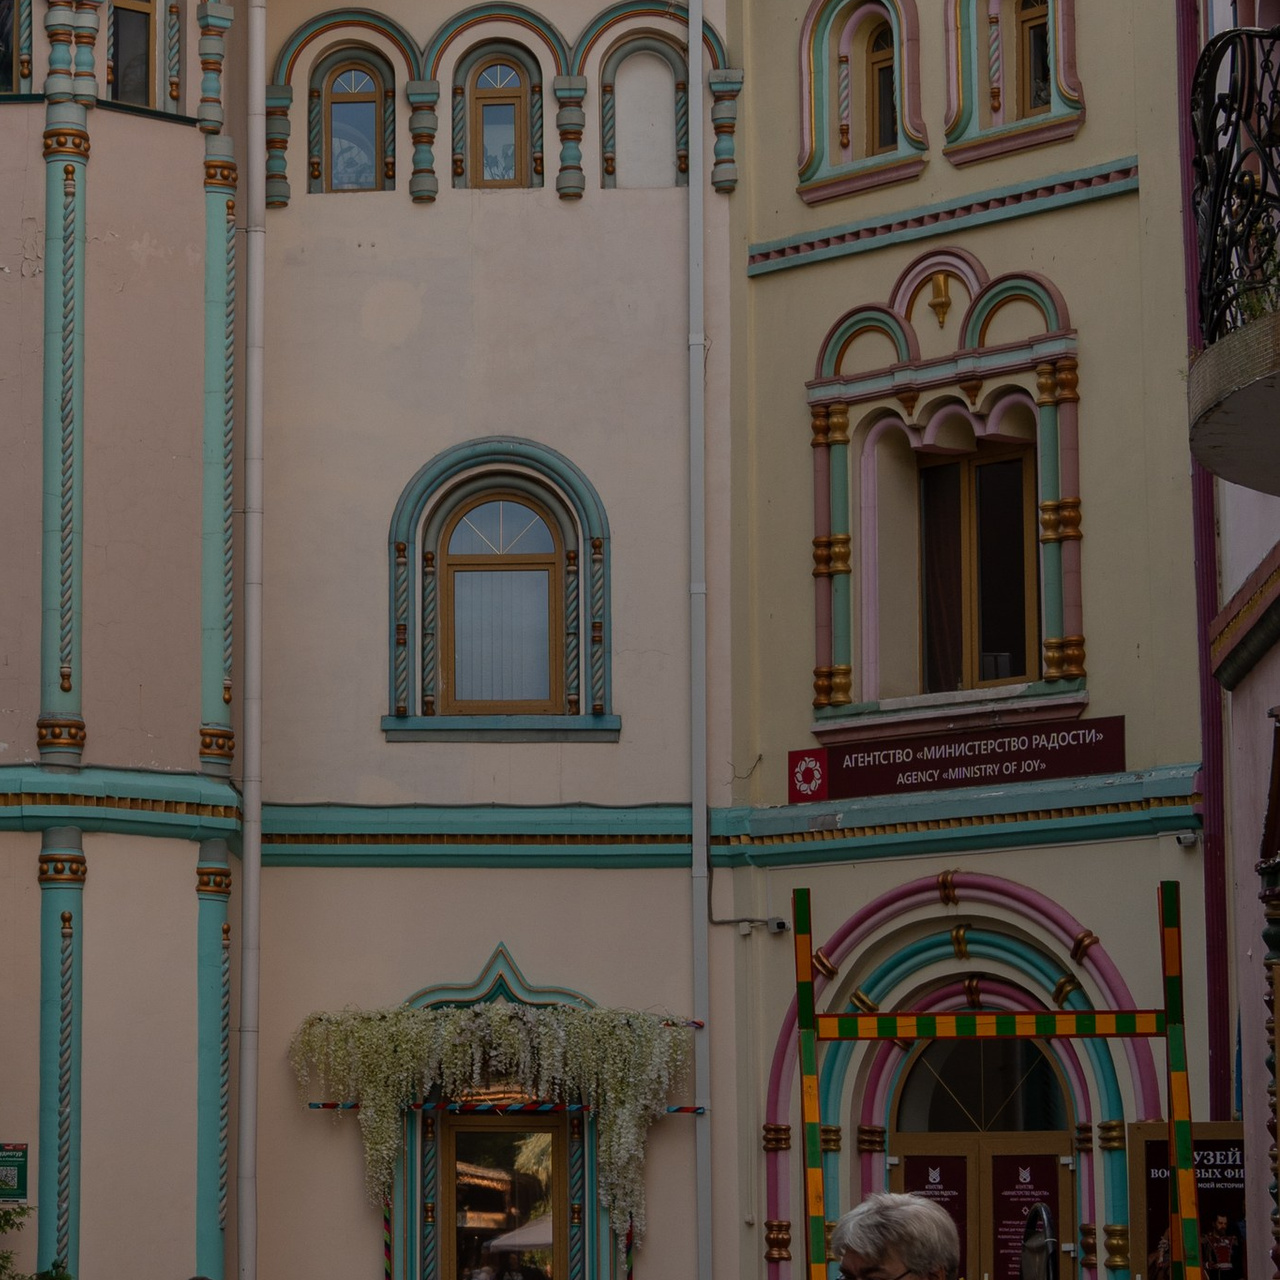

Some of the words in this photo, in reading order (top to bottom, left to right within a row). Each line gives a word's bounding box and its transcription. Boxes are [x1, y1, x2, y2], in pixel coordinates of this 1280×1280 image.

[842, 746, 913, 769] АГЕНТСТВО
[916, 734, 1029, 761] «МИНИСТЕРСТВО
[1032, 728, 1104, 751] РАДОСТИ»
[896, 769, 940, 785] AGENCY
[942, 764, 1000, 781] «MINISTRY
[1003, 761, 1018, 776] OF
[1020, 759, 1046, 776] JOY»
[1194, 1147, 1243, 1165] УЗЕЙ
